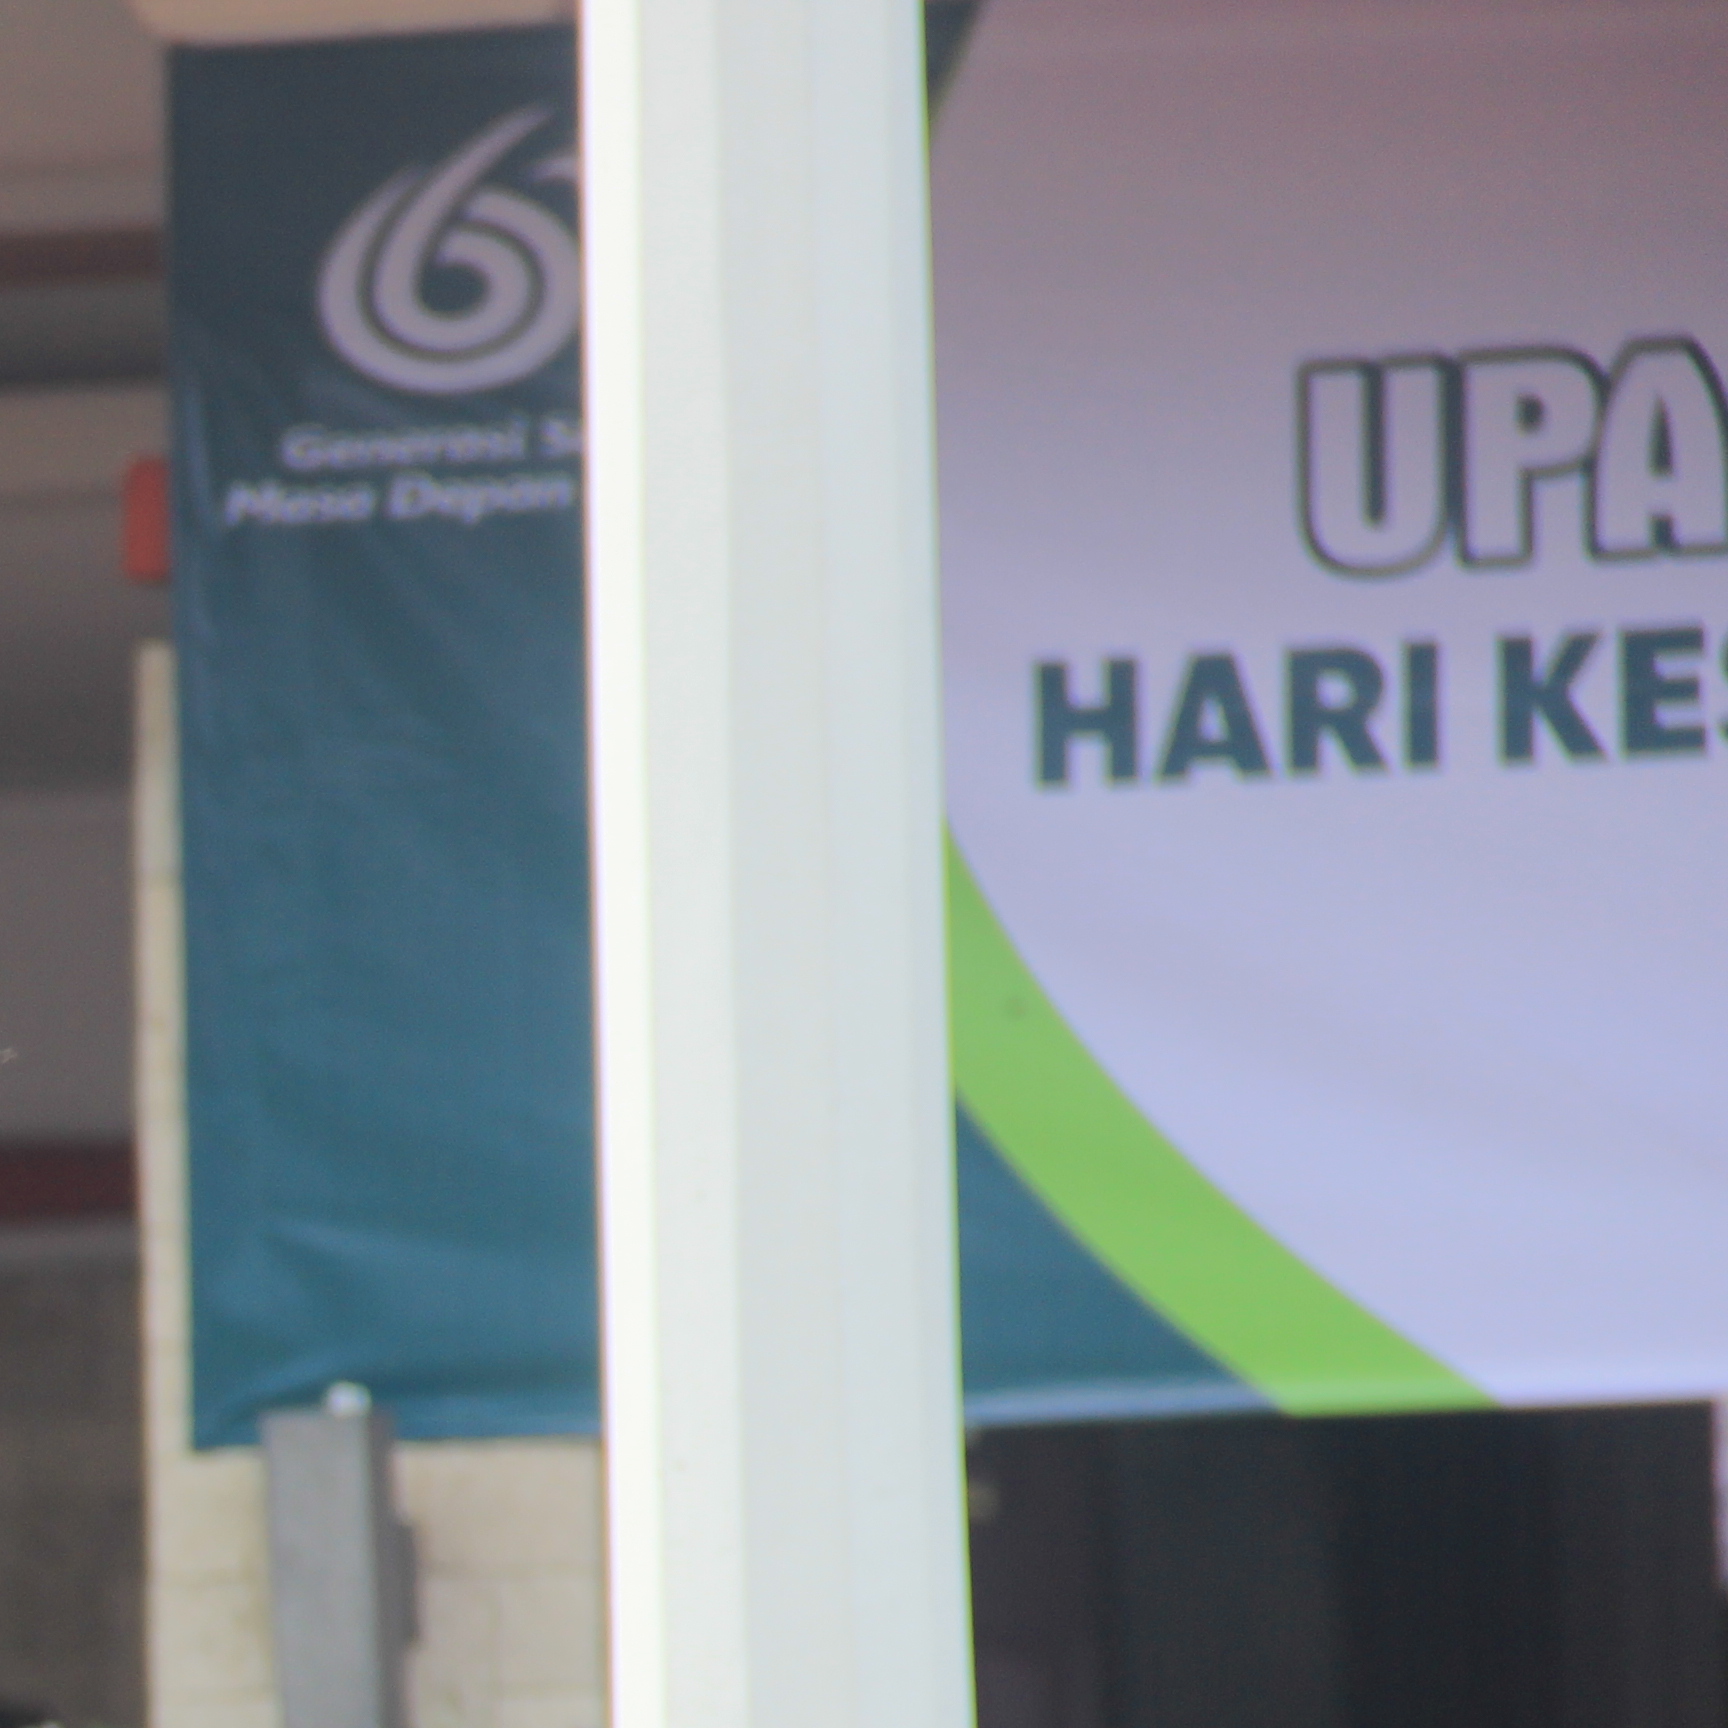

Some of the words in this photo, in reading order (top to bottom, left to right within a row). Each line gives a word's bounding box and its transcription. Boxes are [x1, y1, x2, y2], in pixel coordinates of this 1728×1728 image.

[281, 411, 529, 474] Generasi
[389, 472, 575, 525] Depan
[1034, 637, 1442, 790] HARI
[1496, 620, 1728, 768] KE
